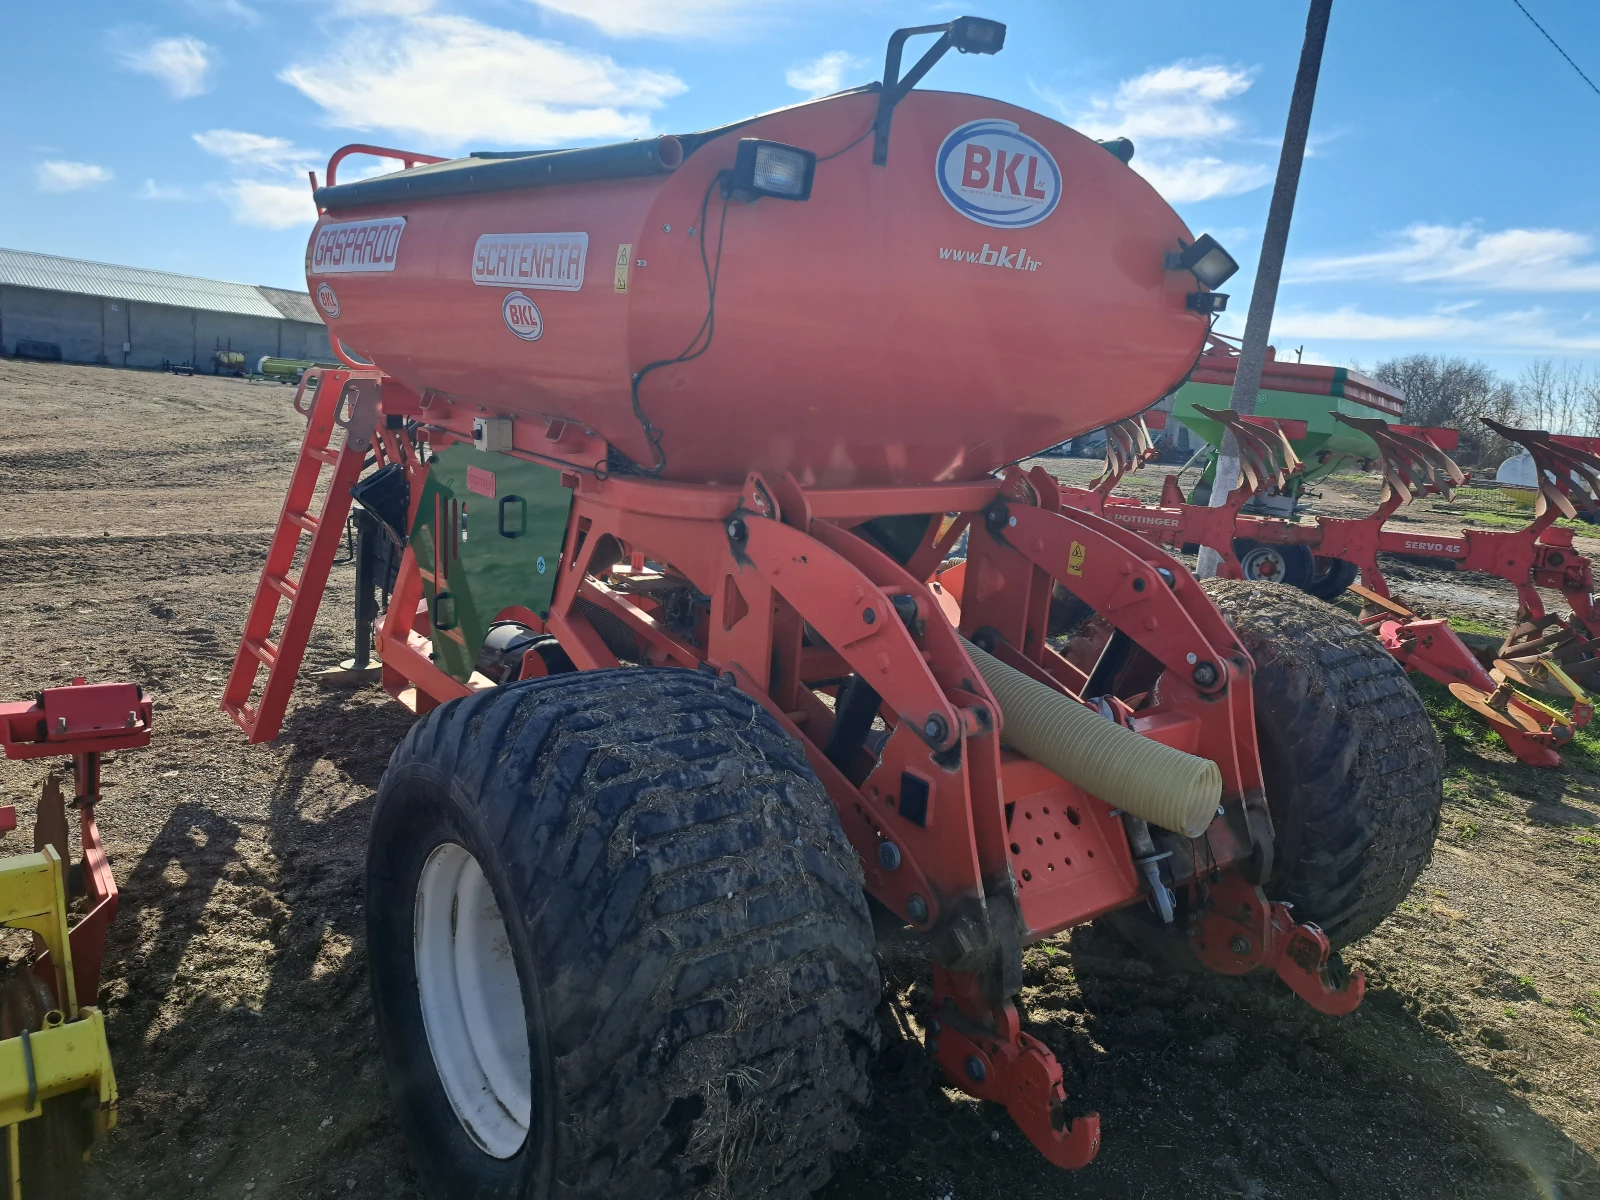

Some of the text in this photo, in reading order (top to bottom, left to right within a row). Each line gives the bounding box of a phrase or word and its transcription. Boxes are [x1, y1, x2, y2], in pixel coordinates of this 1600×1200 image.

[961, 143, 1046, 200] BKL
[314, 224, 402, 266] GASPARDO
[939, 243, 1042, 272] www.bkl.hr
[475, 243, 582, 280] SCATENATA
[320, 291, 337, 307] BKL
[508, 304, 538, 326] BKL
[1405, 541, 1460, 553] SERVO 45
